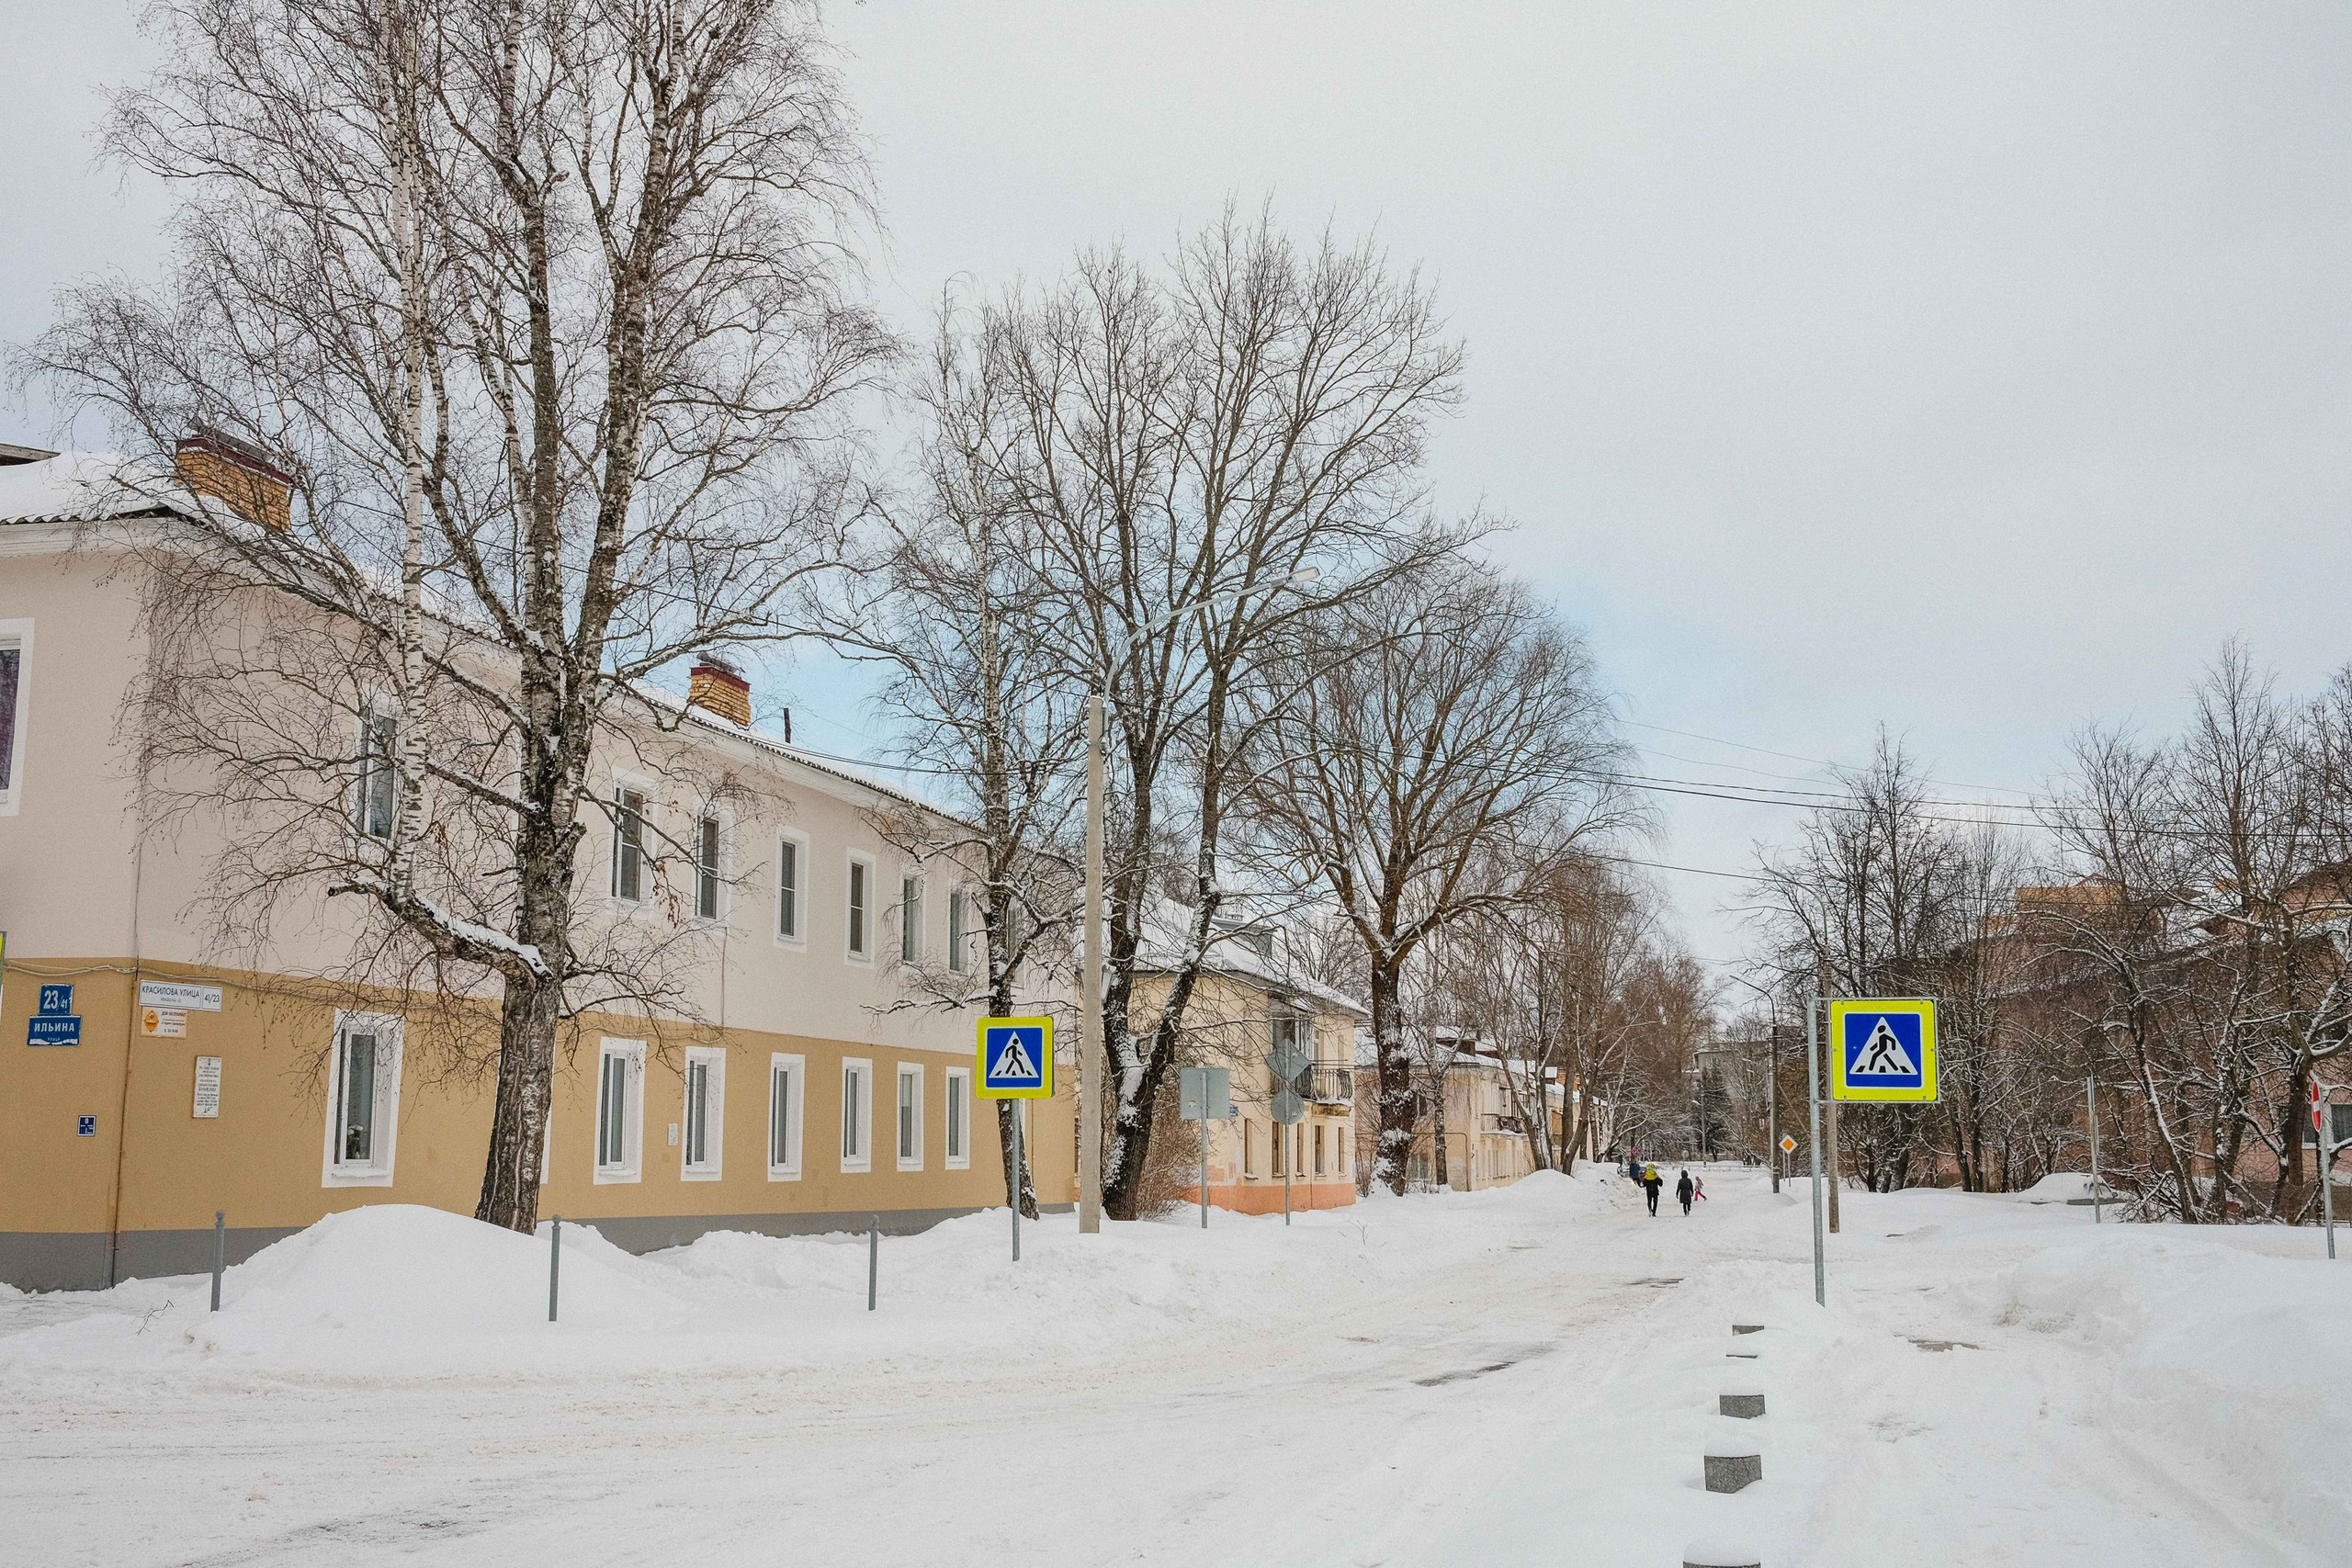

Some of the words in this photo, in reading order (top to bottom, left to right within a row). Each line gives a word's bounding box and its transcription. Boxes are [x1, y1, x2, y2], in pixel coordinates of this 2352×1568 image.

[141, 985, 179, 996] КРАСИЛОВА
[179, 988, 200, 998] УЛИЦА
[204, 993, 220, 1004] 41/23
[34, 1022, 74, 1032] ИЛЬИНА
